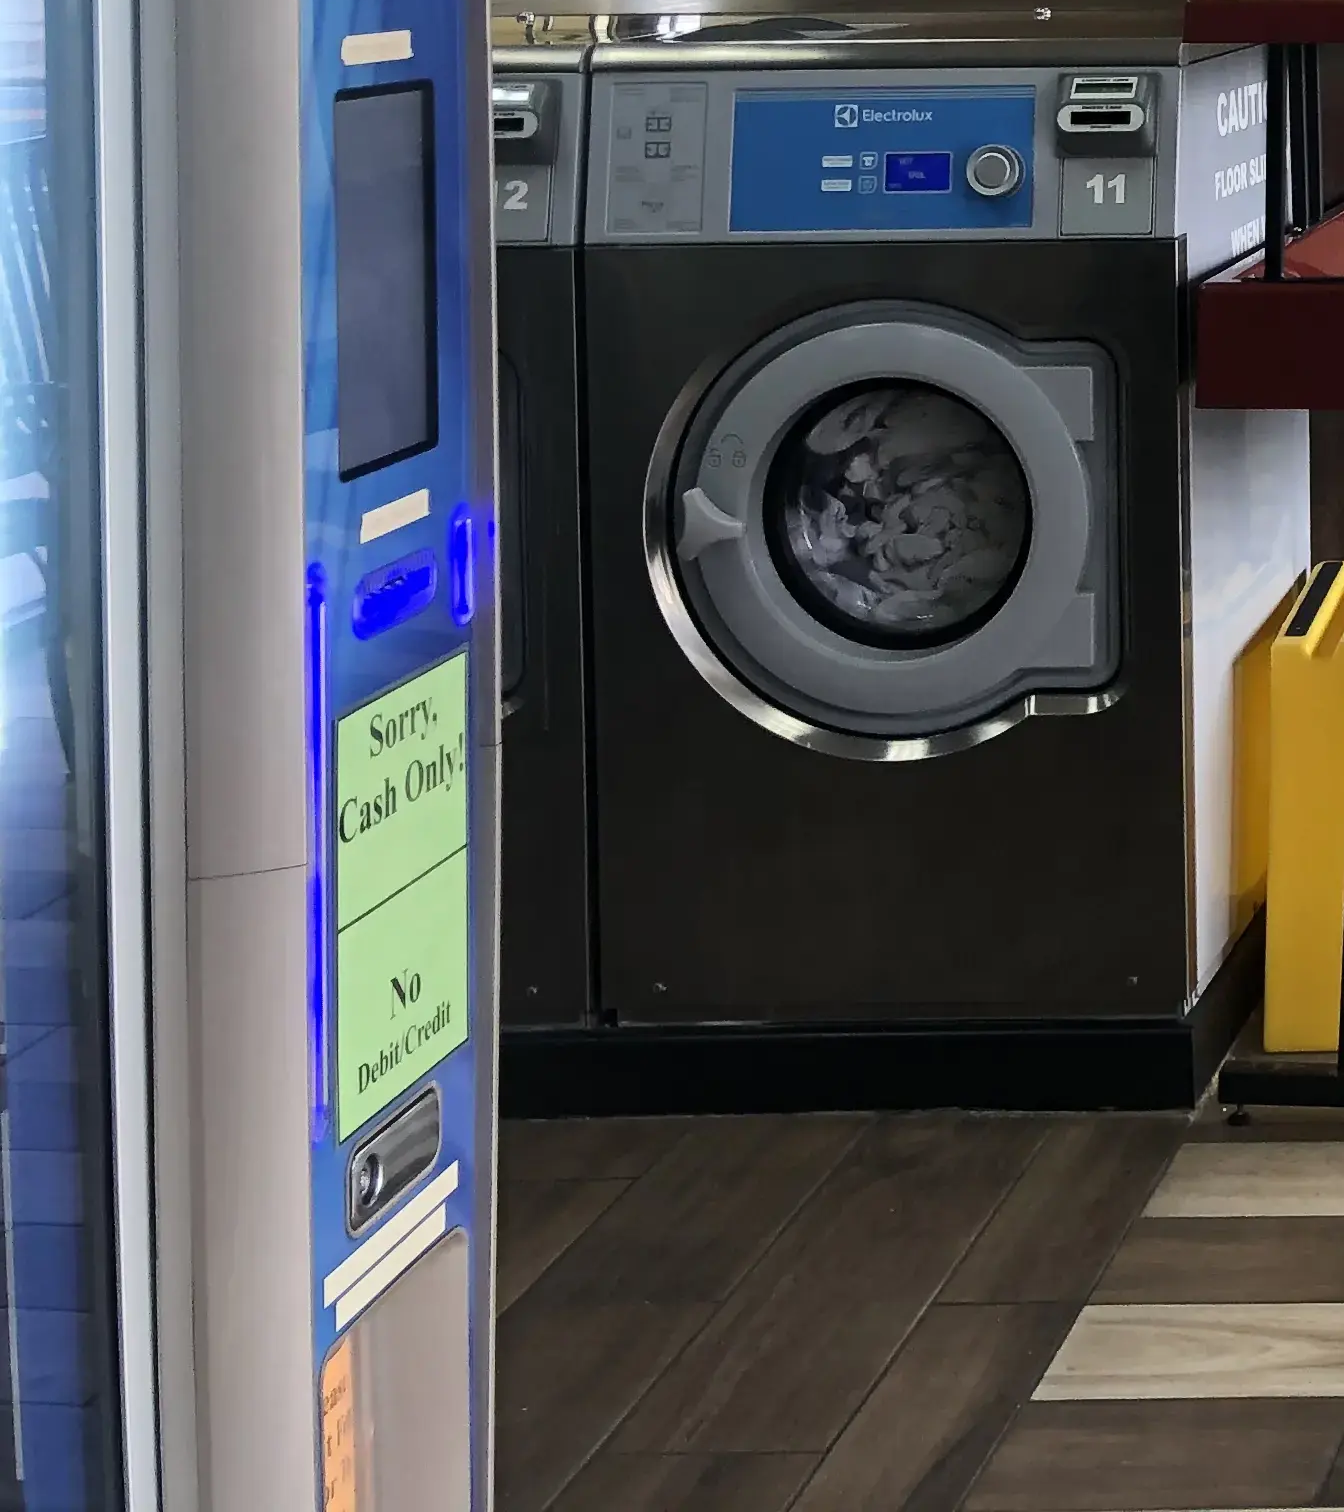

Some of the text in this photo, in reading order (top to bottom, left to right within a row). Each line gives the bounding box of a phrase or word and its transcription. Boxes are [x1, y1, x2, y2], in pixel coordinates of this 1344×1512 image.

[862, 109, 933, 122] Electrolux
[495, 179, 529, 210] 2
[1086, 174, 1126, 204] 11
[1214, 161, 1247, 201] FLOOR
[1230, 218, 1260, 258] WHEN
[339, 733, 464, 843] Cash Only!
[390, 969, 421, 1020] No
[357, 1000, 451, 1095] Debit/Credit
